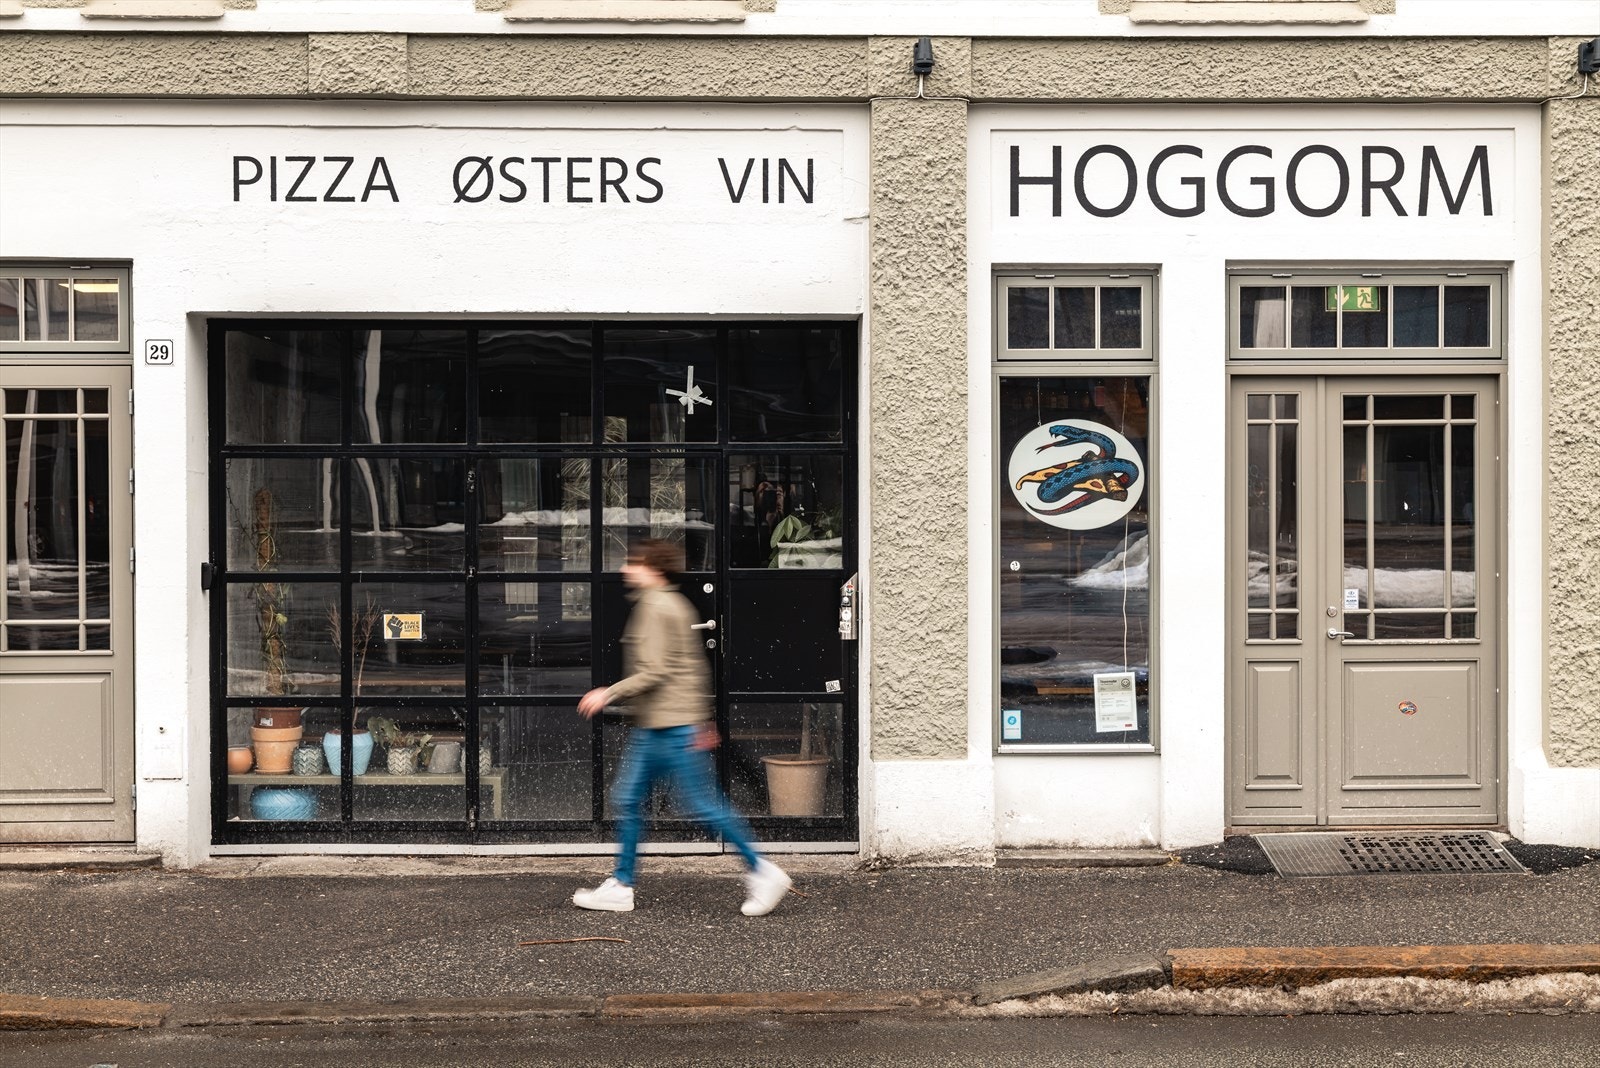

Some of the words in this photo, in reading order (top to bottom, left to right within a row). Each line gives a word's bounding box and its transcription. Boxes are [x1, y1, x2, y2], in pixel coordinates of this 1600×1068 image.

[233, 156, 399, 202] PIZZA
[453, 156, 664, 203] ØSTERS
[718, 158, 814, 203] VIN
[1009, 144, 1493, 218] HOGGORM
[149, 344, 169, 360] 29
